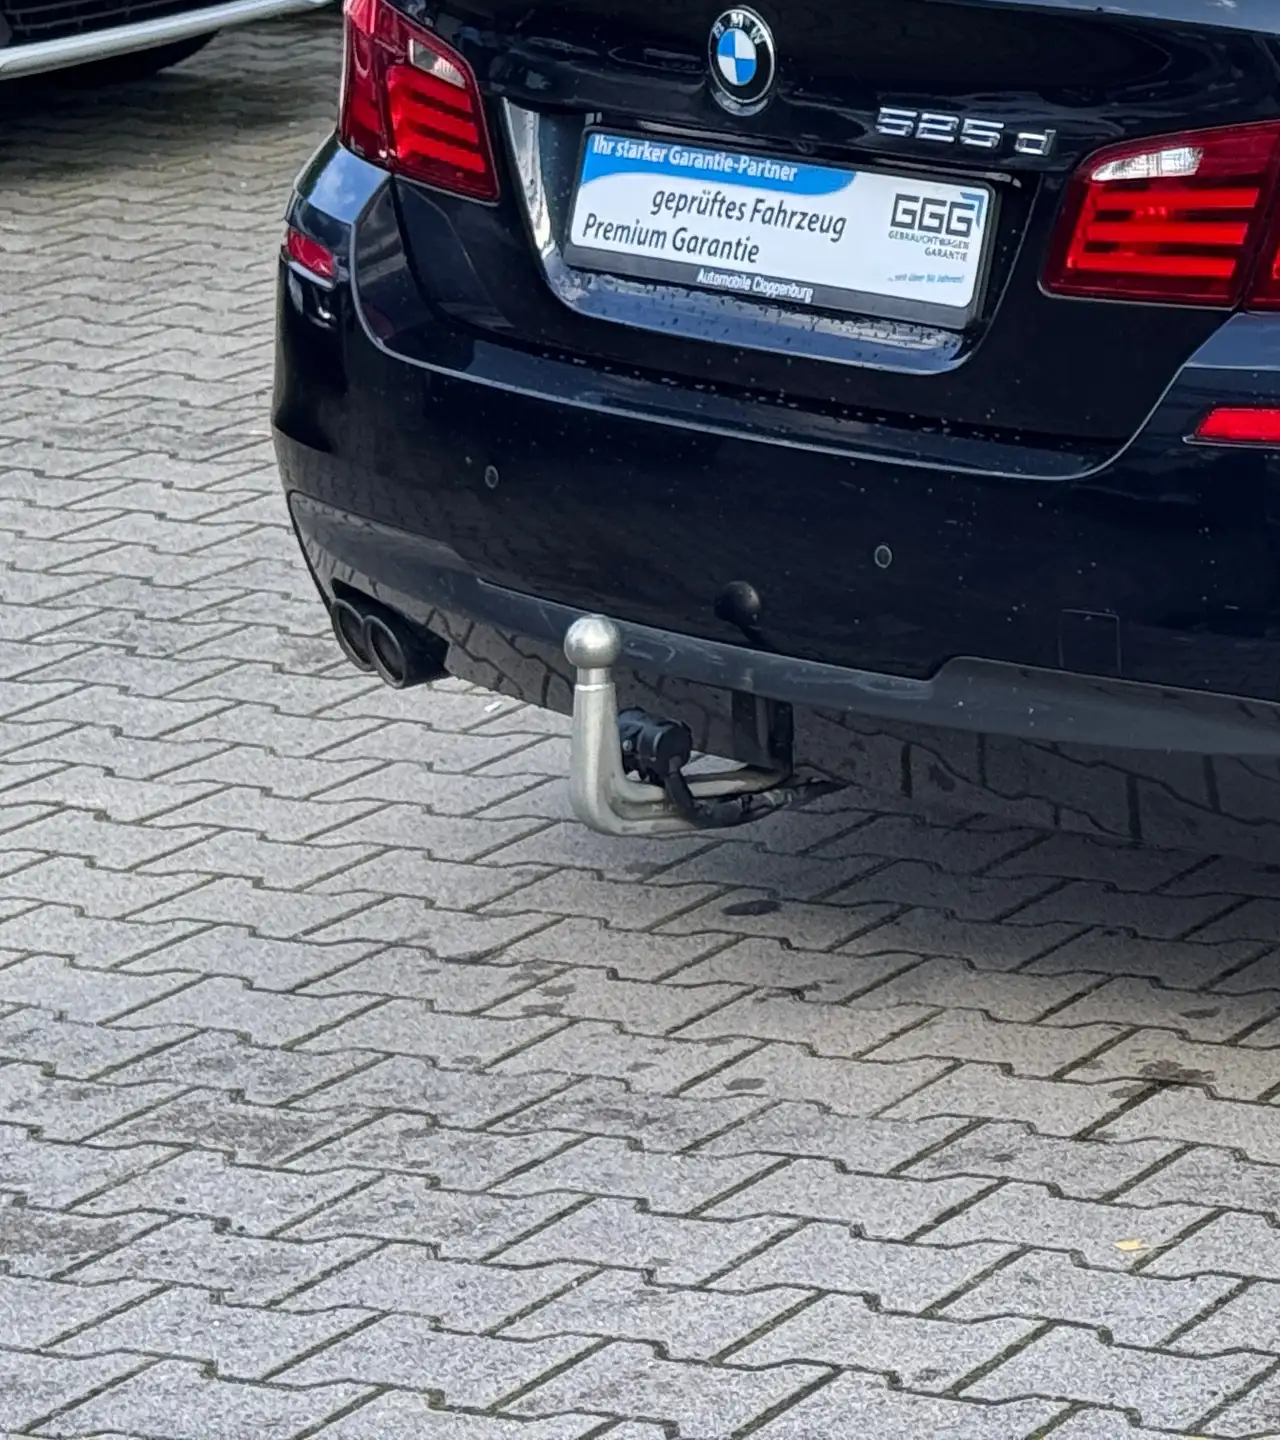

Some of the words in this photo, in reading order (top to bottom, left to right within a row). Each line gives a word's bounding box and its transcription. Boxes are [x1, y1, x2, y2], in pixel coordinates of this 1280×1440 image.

[712, 12, 767, 46] BMW
[875, 107, 1005, 149] 525
[592, 134, 613, 155] Ihr
[616, 139, 667, 163] starker
[669, 146, 799, 182] Garantie-Partner
[650, 188, 748, 222] geprüftes
[749, 197, 848, 243] Fahrzeug
[890, 192, 976, 239] GGG
[582, 212, 668, 251] Premium
[671, 226, 761, 264] Garantie
[924, 247, 969, 263] GARANTIE
[696, 268, 751, 293] Automobile
